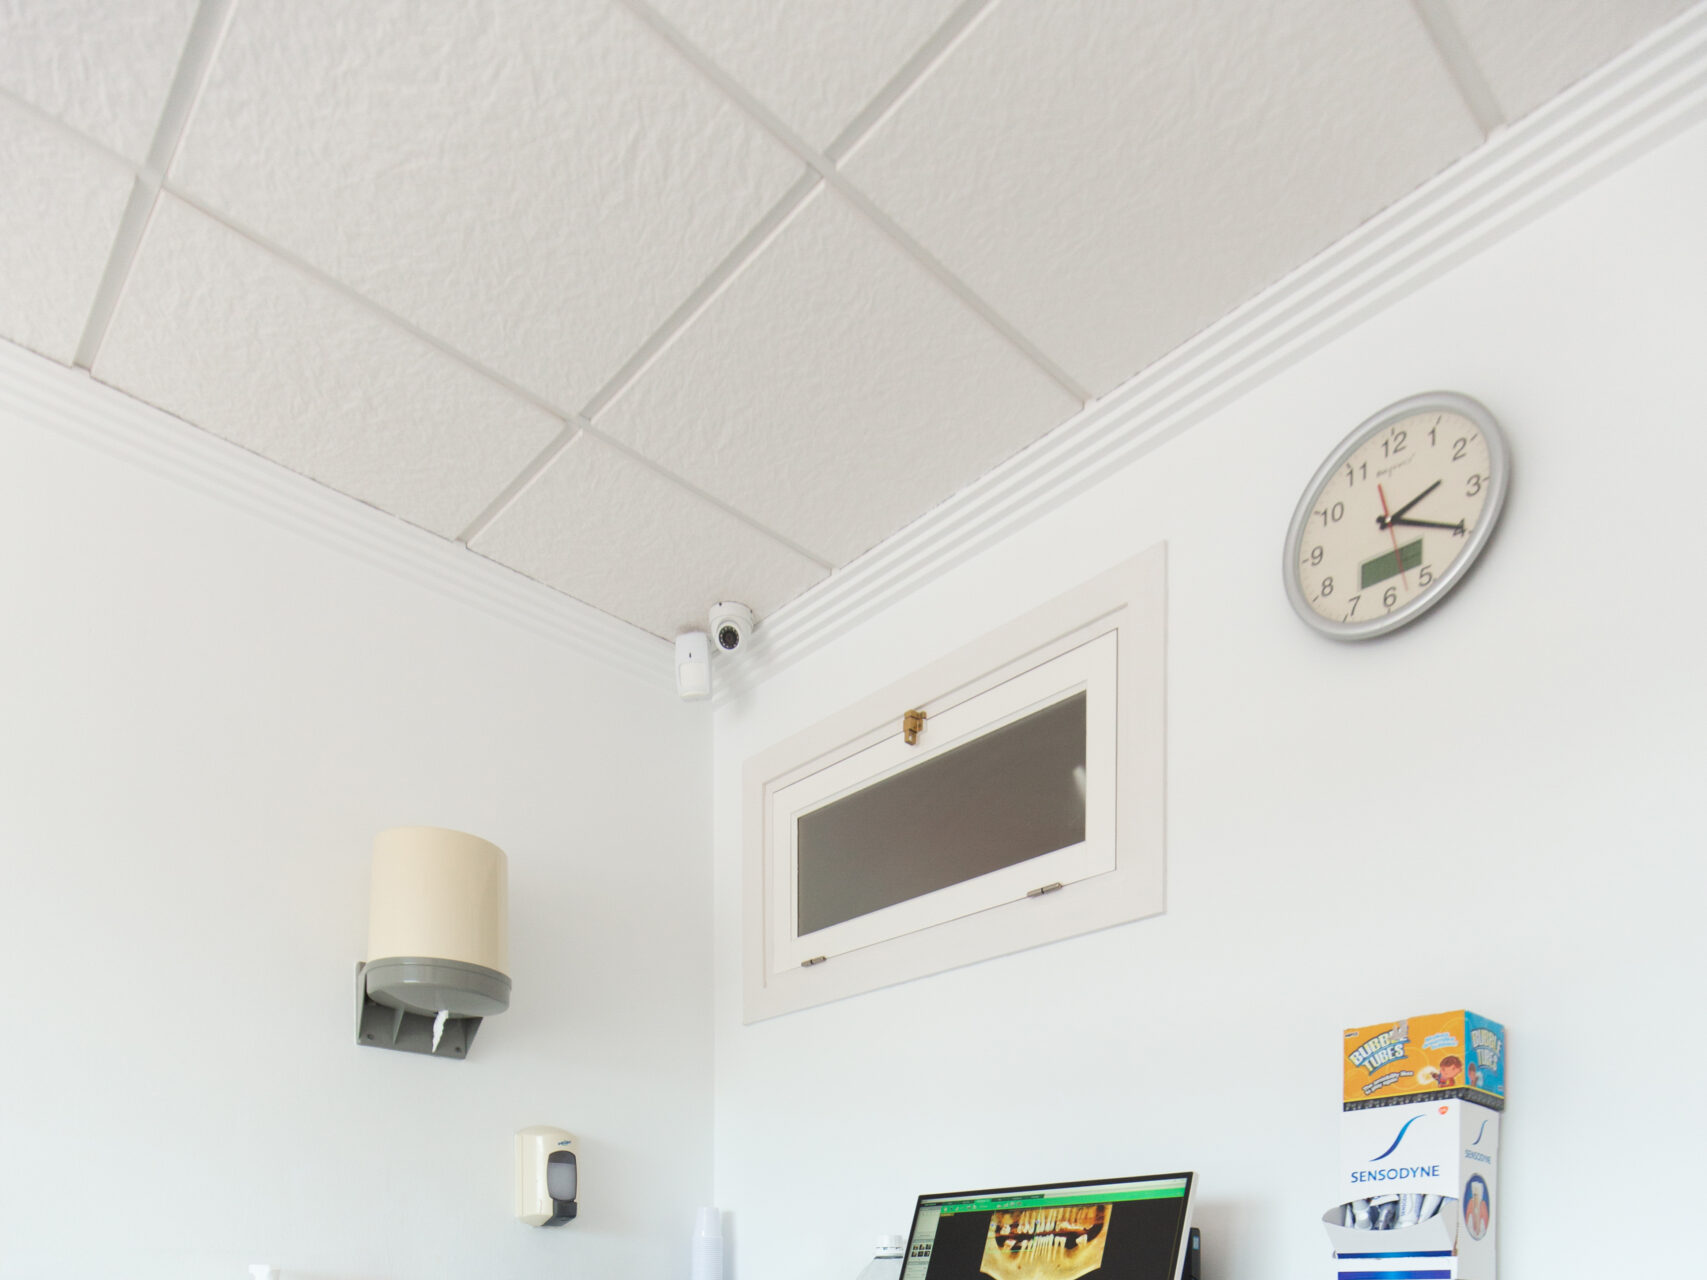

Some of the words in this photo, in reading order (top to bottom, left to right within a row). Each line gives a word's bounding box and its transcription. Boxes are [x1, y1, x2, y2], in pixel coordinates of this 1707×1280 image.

[1381, 431, 1407, 458] 12
[1428, 427, 1437, 447] 1
[1452, 437, 1468, 461] 2
[1346, 461, 1367, 487] 11
[1466, 474, 1481, 497] 3
[1320, 502, 1345, 527] 10
[1310, 545, 1324, 567] 9
[1321, 576, 1334, 597] 8
[1418, 564, 1433, 587] 5
[1348, 595, 1361, 617] 7
[1383, 586, 1398, 608] 6
[1364, 1044, 1405, 1072] TUBES
[1351, 1164, 1440, 1183] SENSODYNE
